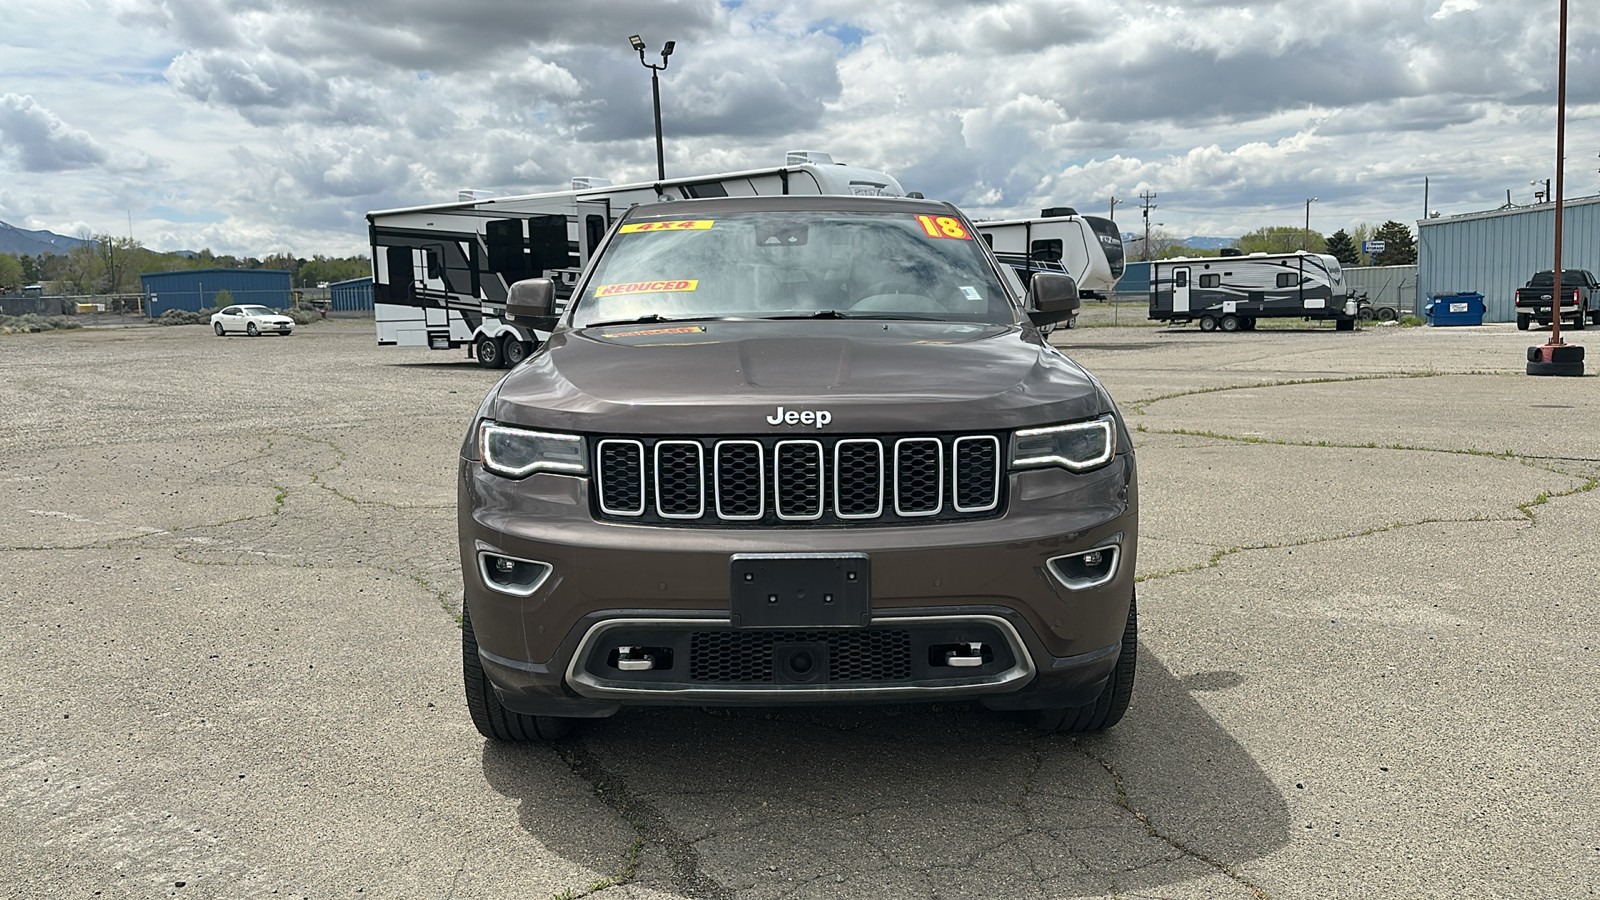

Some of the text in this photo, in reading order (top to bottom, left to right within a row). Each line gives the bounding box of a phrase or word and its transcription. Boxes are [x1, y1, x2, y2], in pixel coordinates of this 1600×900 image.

[918, 215, 967, 239] 18
[601, 280, 692, 295] REDUCED
[766, 406, 832, 429] Jeep
